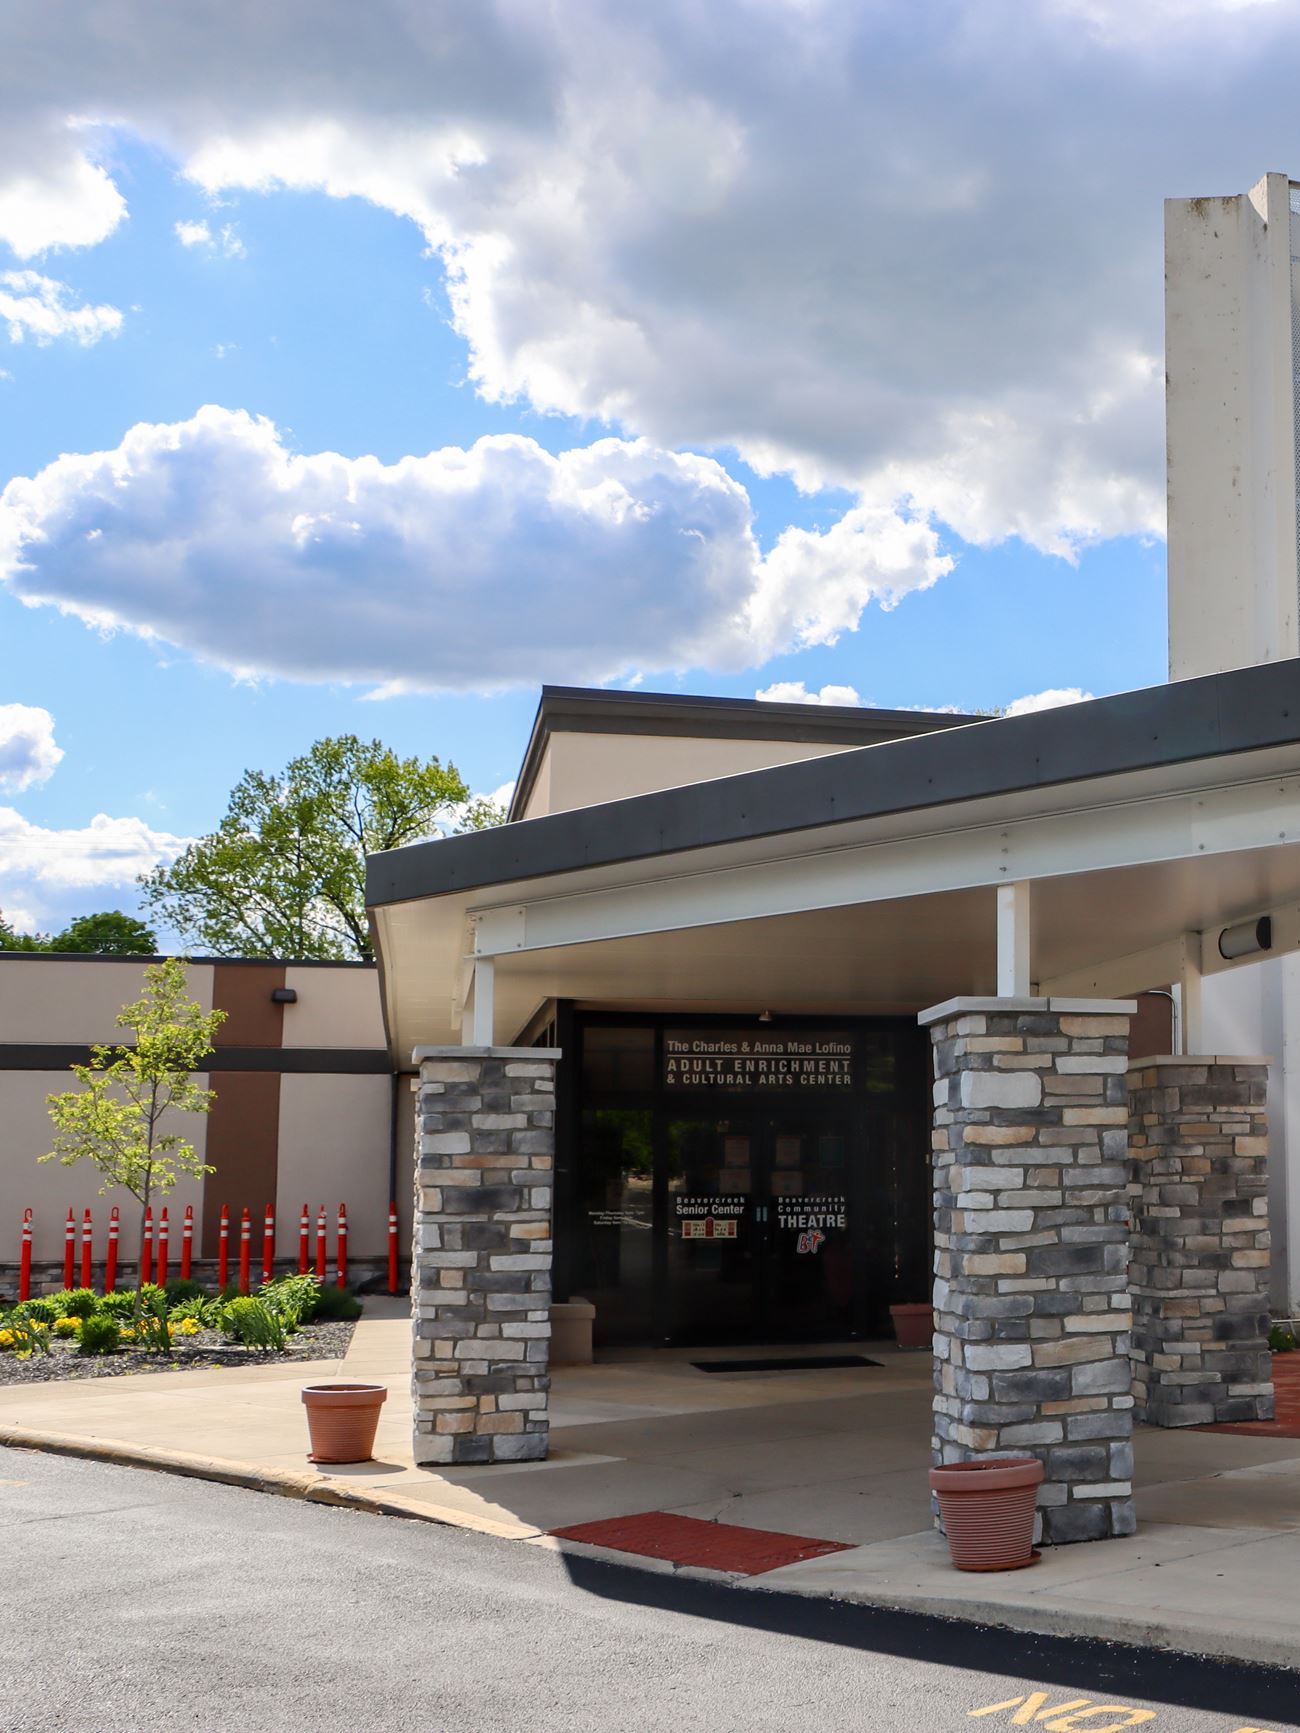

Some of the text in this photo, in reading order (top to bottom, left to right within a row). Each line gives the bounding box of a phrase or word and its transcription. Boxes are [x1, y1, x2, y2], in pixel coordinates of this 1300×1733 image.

[667, 1040, 851, 1054] The Charles & Anna Mae Lofino
[667, 1059, 850, 1073] ADULT ENRICHMENT
[666, 1073, 851, 1085] & CULTURAL ARTS CENTER
[676, 1196, 745, 1204] Beavercreek
[675, 1204, 745, 1215] Senior Center
[777, 1204, 846, 1213] Community
[778, 1214, 846, 1228] THEATRE
[966, 1691, 1158, 1733] NO
